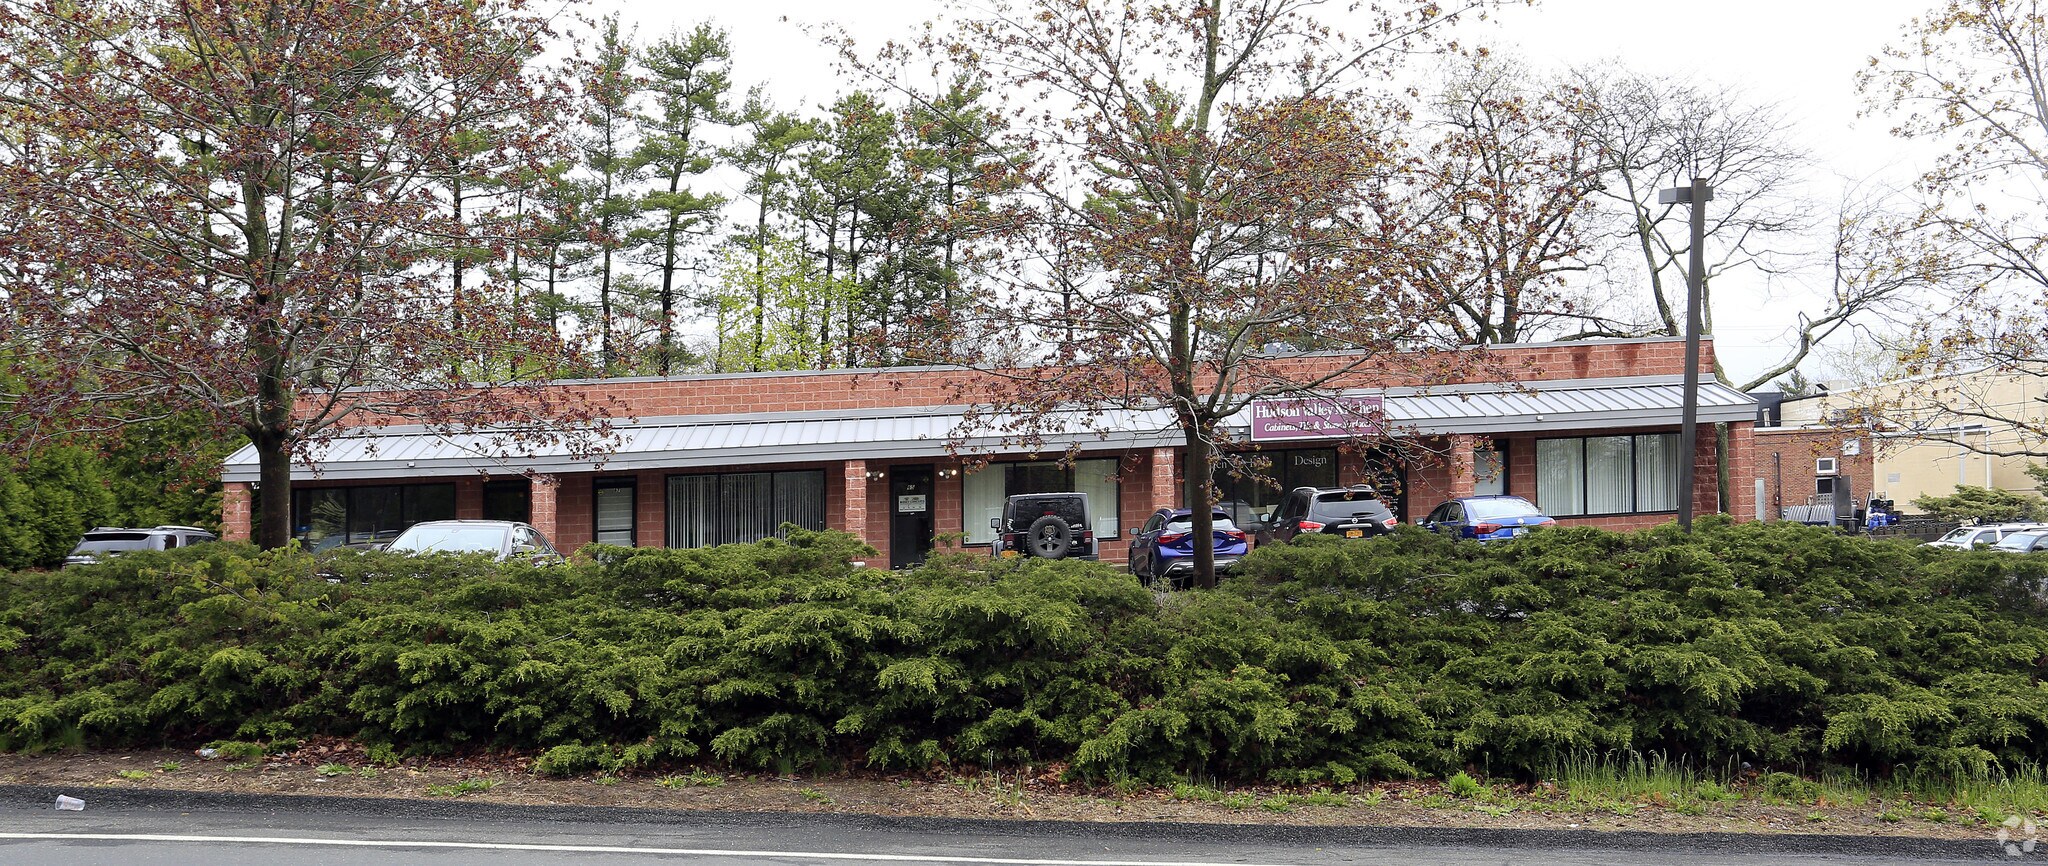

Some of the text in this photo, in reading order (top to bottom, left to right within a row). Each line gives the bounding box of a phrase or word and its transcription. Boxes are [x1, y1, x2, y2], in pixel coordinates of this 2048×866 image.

[1256, 403, 1300, 418] Hudson
[1313, 420, 1322, 431] &
[1294, 455, 1328, 467] Design
